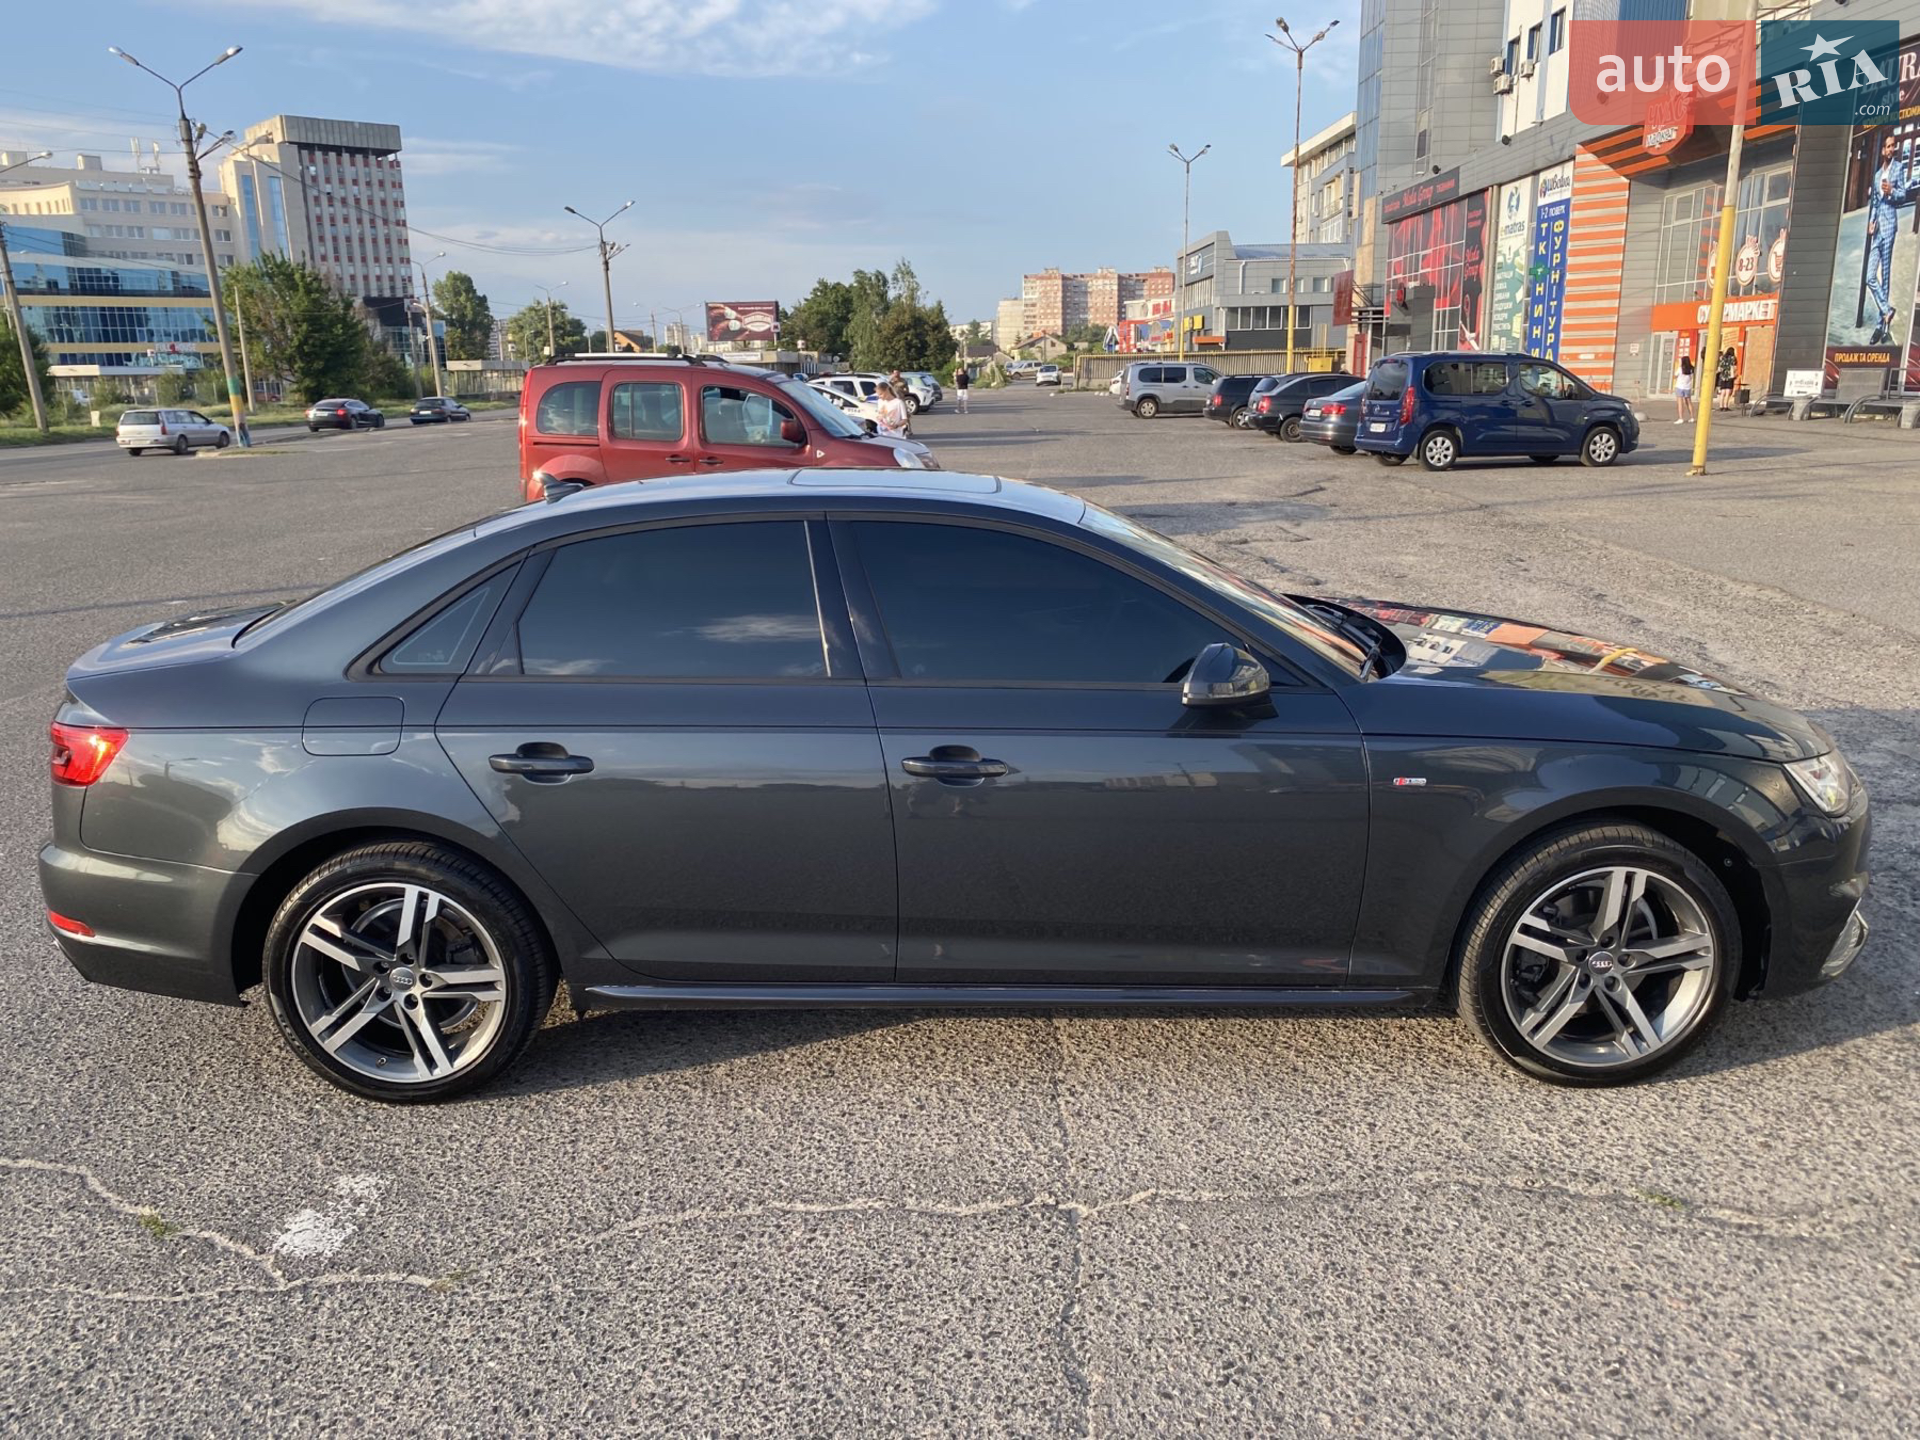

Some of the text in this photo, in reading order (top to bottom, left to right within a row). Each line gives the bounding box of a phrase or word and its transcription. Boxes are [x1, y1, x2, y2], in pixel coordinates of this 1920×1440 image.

[1531, 222, 1548, 358] ТКНИНИ
[1545, 220, 1564, 361] ФУРНІТУРА
[1738, 256, 1754, 272] 8-23
[1834, 353, 1858, 362] ПРОДАЖ
[1867, 353, 1890, 362] ОРЕНДА
